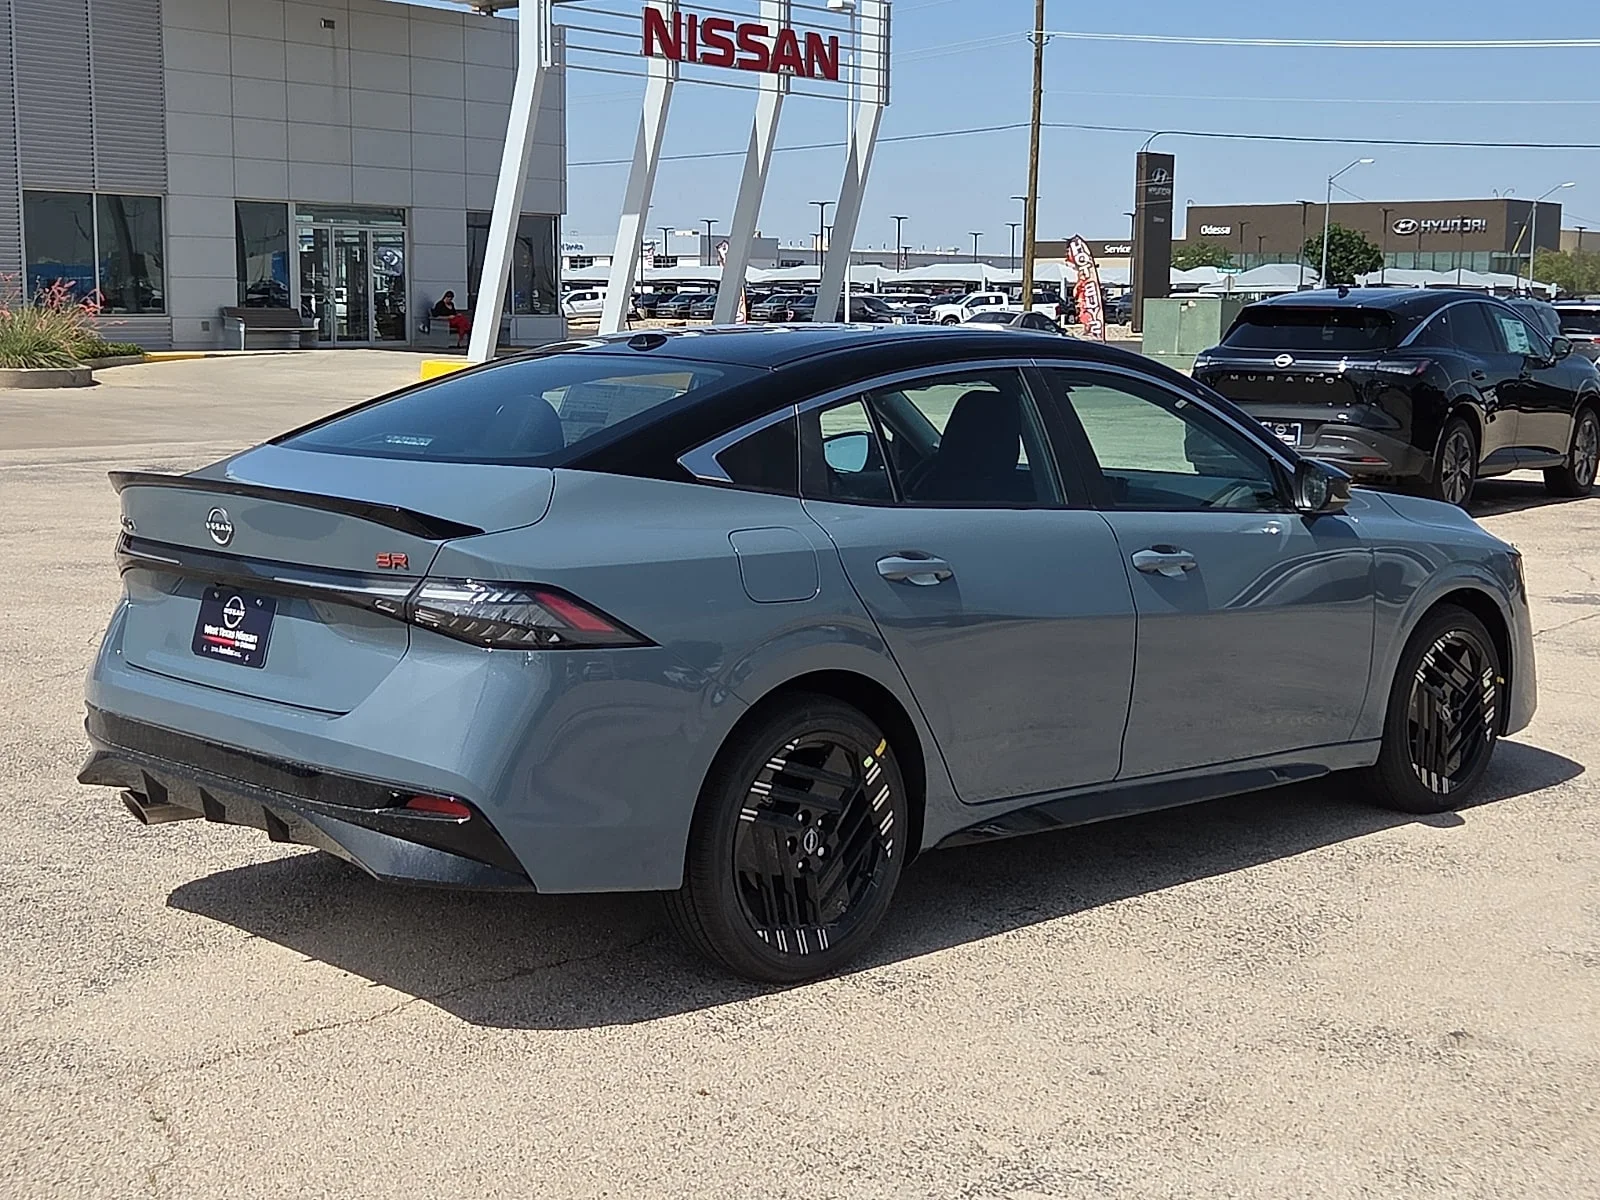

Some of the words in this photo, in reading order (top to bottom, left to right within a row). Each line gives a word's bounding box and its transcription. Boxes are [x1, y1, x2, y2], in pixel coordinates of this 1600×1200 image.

[643, 6, 839, 81] NISSAN
[1200, 225, 1231, 235] Odessa
[1421, 219, 1486, 232] HYUNDAI
[1104, 244, 1131, 254] Service
[1230, 374, 1335, 384] MURANO
[376, 551, 409, 570] SR
